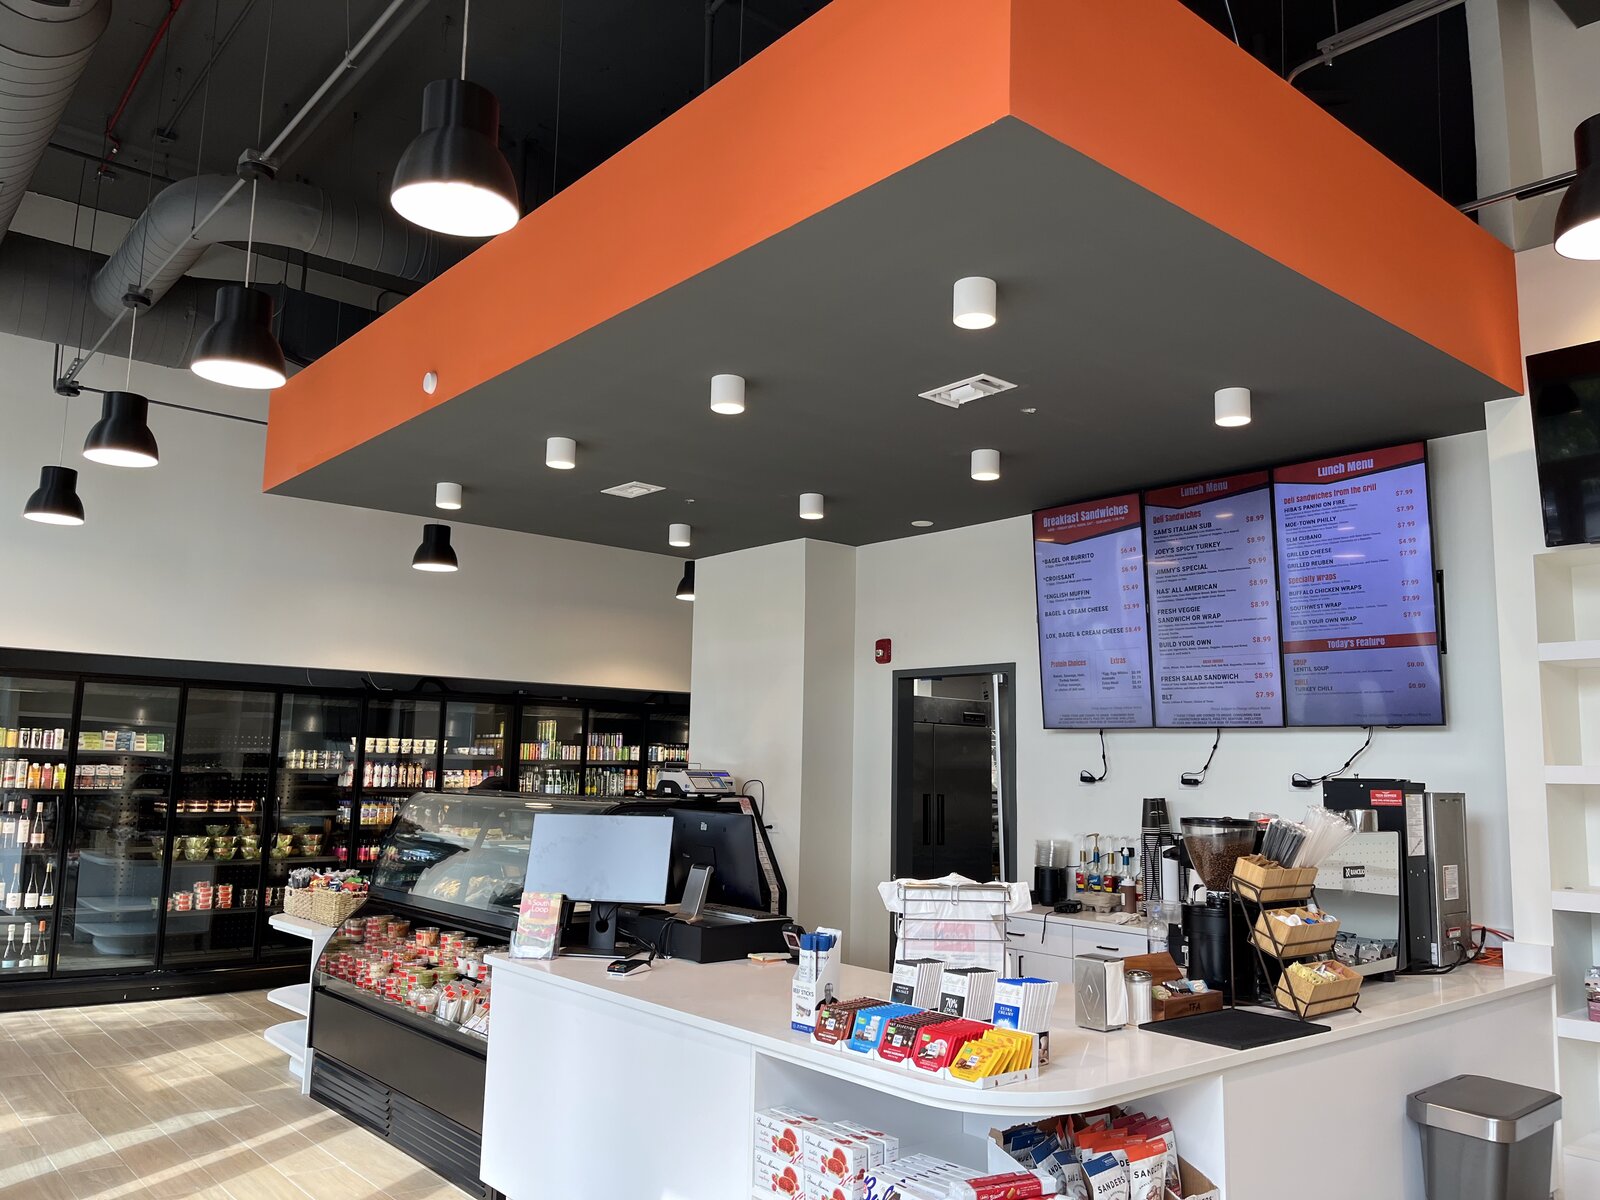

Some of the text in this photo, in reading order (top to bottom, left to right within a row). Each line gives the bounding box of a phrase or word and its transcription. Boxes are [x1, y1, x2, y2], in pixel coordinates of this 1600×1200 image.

[1318, 458, 1374, 476] Lunch Menu
[1180, 481, 1228, 497] Lunch Menu
[1284, 483, 1377, 504] Deli Sandwiches from the Grill
[1303, 503, 1322, 511] PANINI
[1043, 512, 1079, 528] Breakfast
[1081, 504, 1129, 521] Sandwiches
[1153, 510, 1201, 524] Deli Sandwiches
[1285, 519, 1316, 528] MOE-TOWN
[1317, 516, 1337, 525] PHILLY
[1173, 525, 1198, 534] ITALIAN
[1155, 548, 1174, 556] JOEY'S
[1176, 545, 1195, 553] SPICY
[1196, 542, 1221, 550] TURKEY
[1070, 553, 1094, 561] BURRITO
[1155, 567, 1180, 575] JIMMY'S
[1182, 564, 1208, 573] SPECIAL
[1288, 575, 1315, 585] Specialty
[1317, 573, 1337, 582] Wraps
[1183, 583, 1218, 592] AMERICAN
[1070, 590, 1090, 598] MUFFIN
[1328, 637, 1385, 648] Today's Feature
[801, 989, 814, 997] STICKS
[946, 997, 958, 1008] 70%
[1097, 1175, 1126, 1194] SANDERS
